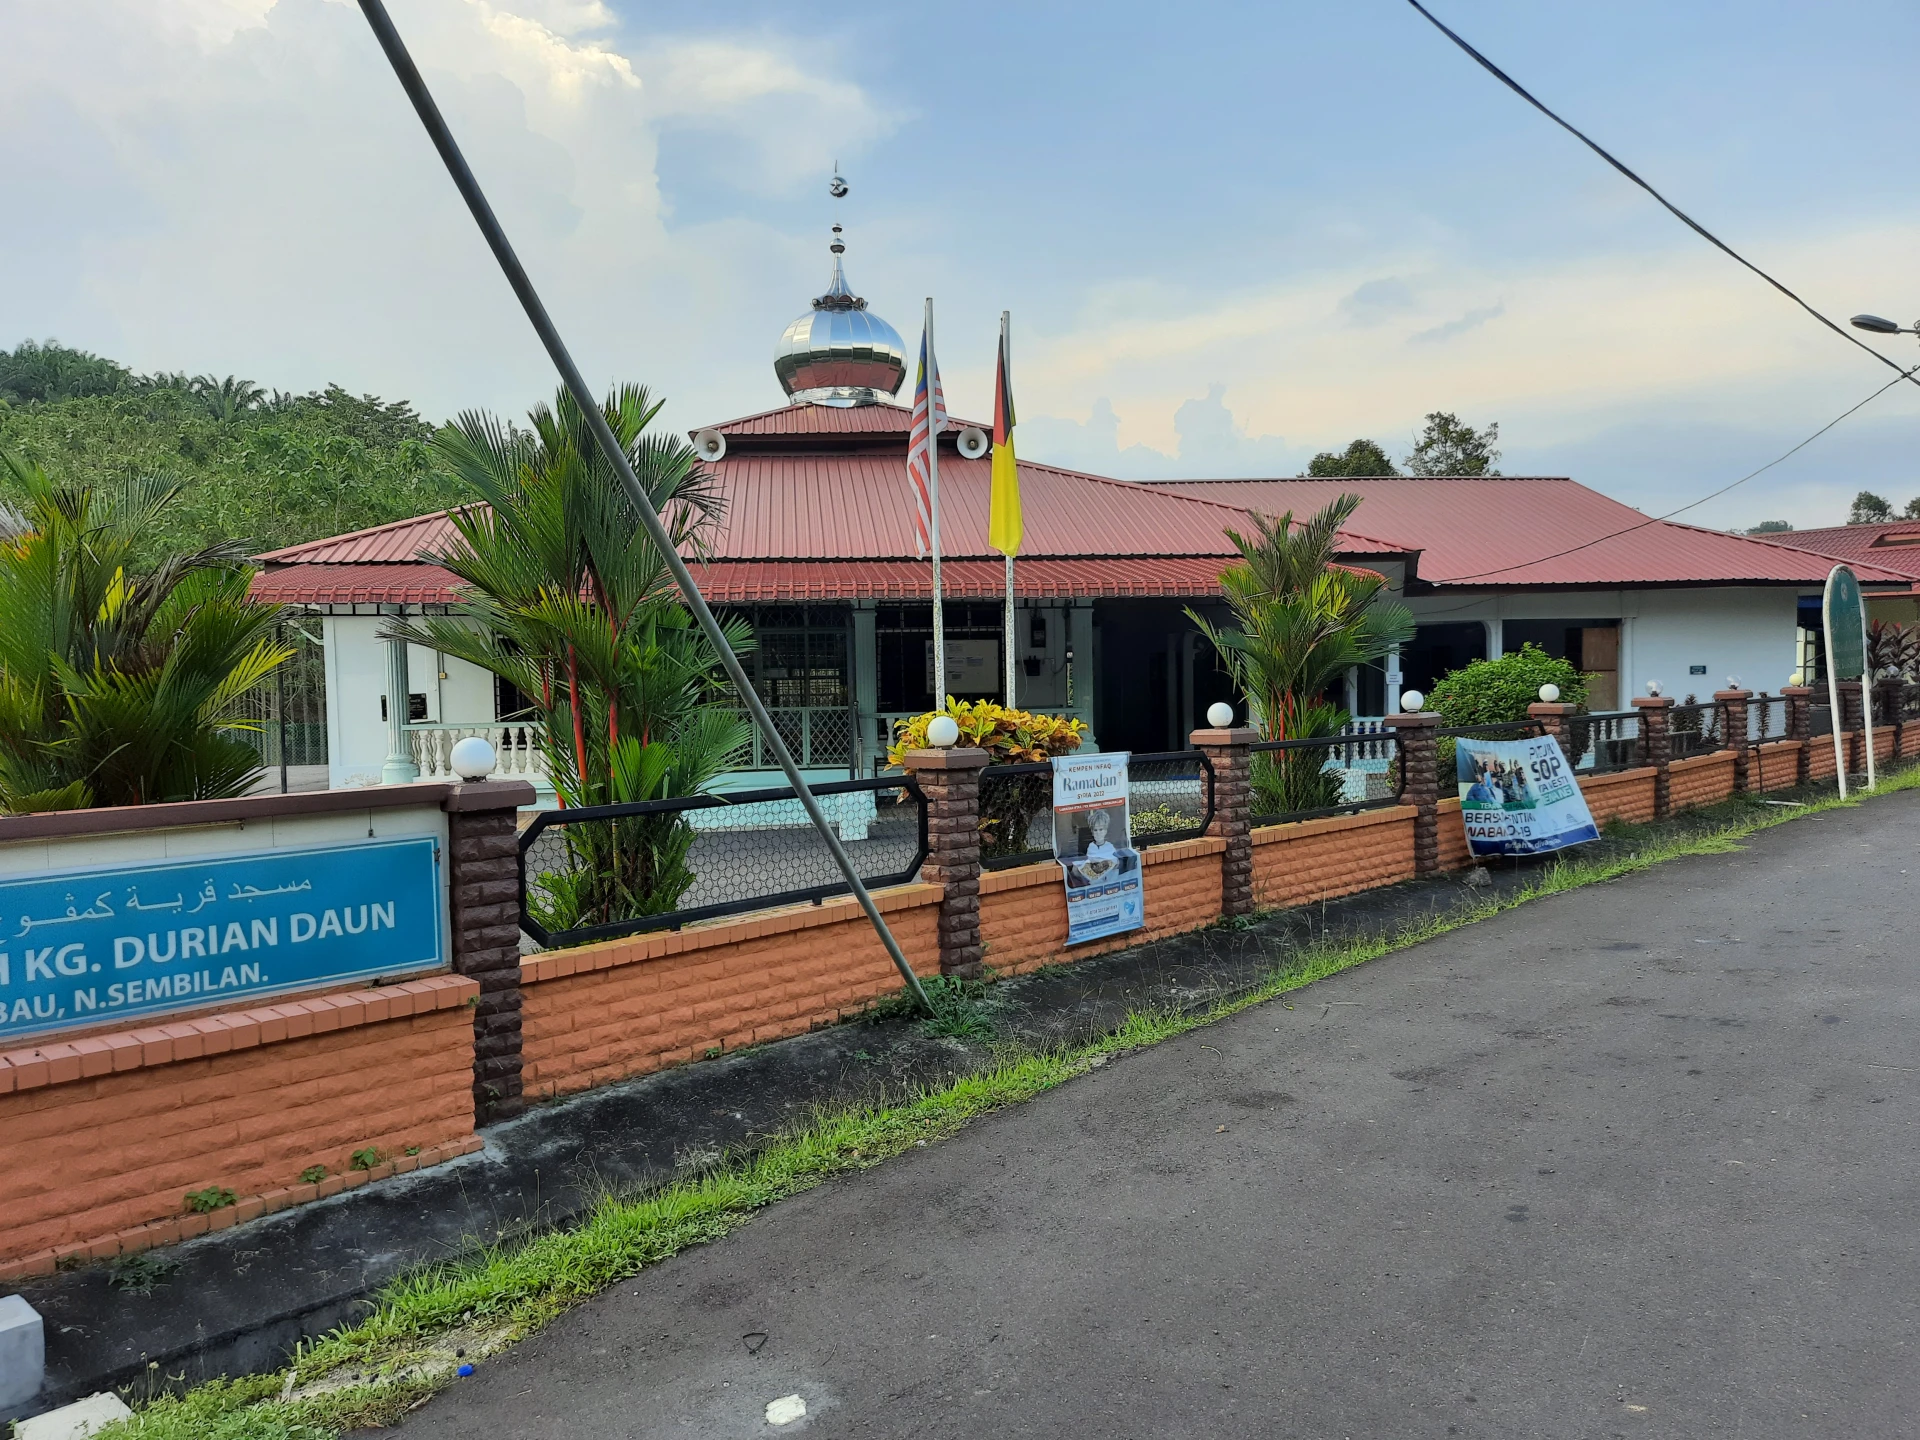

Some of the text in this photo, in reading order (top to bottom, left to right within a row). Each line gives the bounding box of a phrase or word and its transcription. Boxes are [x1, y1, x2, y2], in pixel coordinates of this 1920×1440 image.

[1531, 756, 1561, 782] SOP
[1063, 773, 1117, 792] Ramadan
[126, 877, 217, 914] قرية
[228, 878, 312, 903] مسجد
[25, 943, 101, 982] KG.
[114, 916, 278, 969] DURIAN
[290, 900, 396, 944] DAUN
